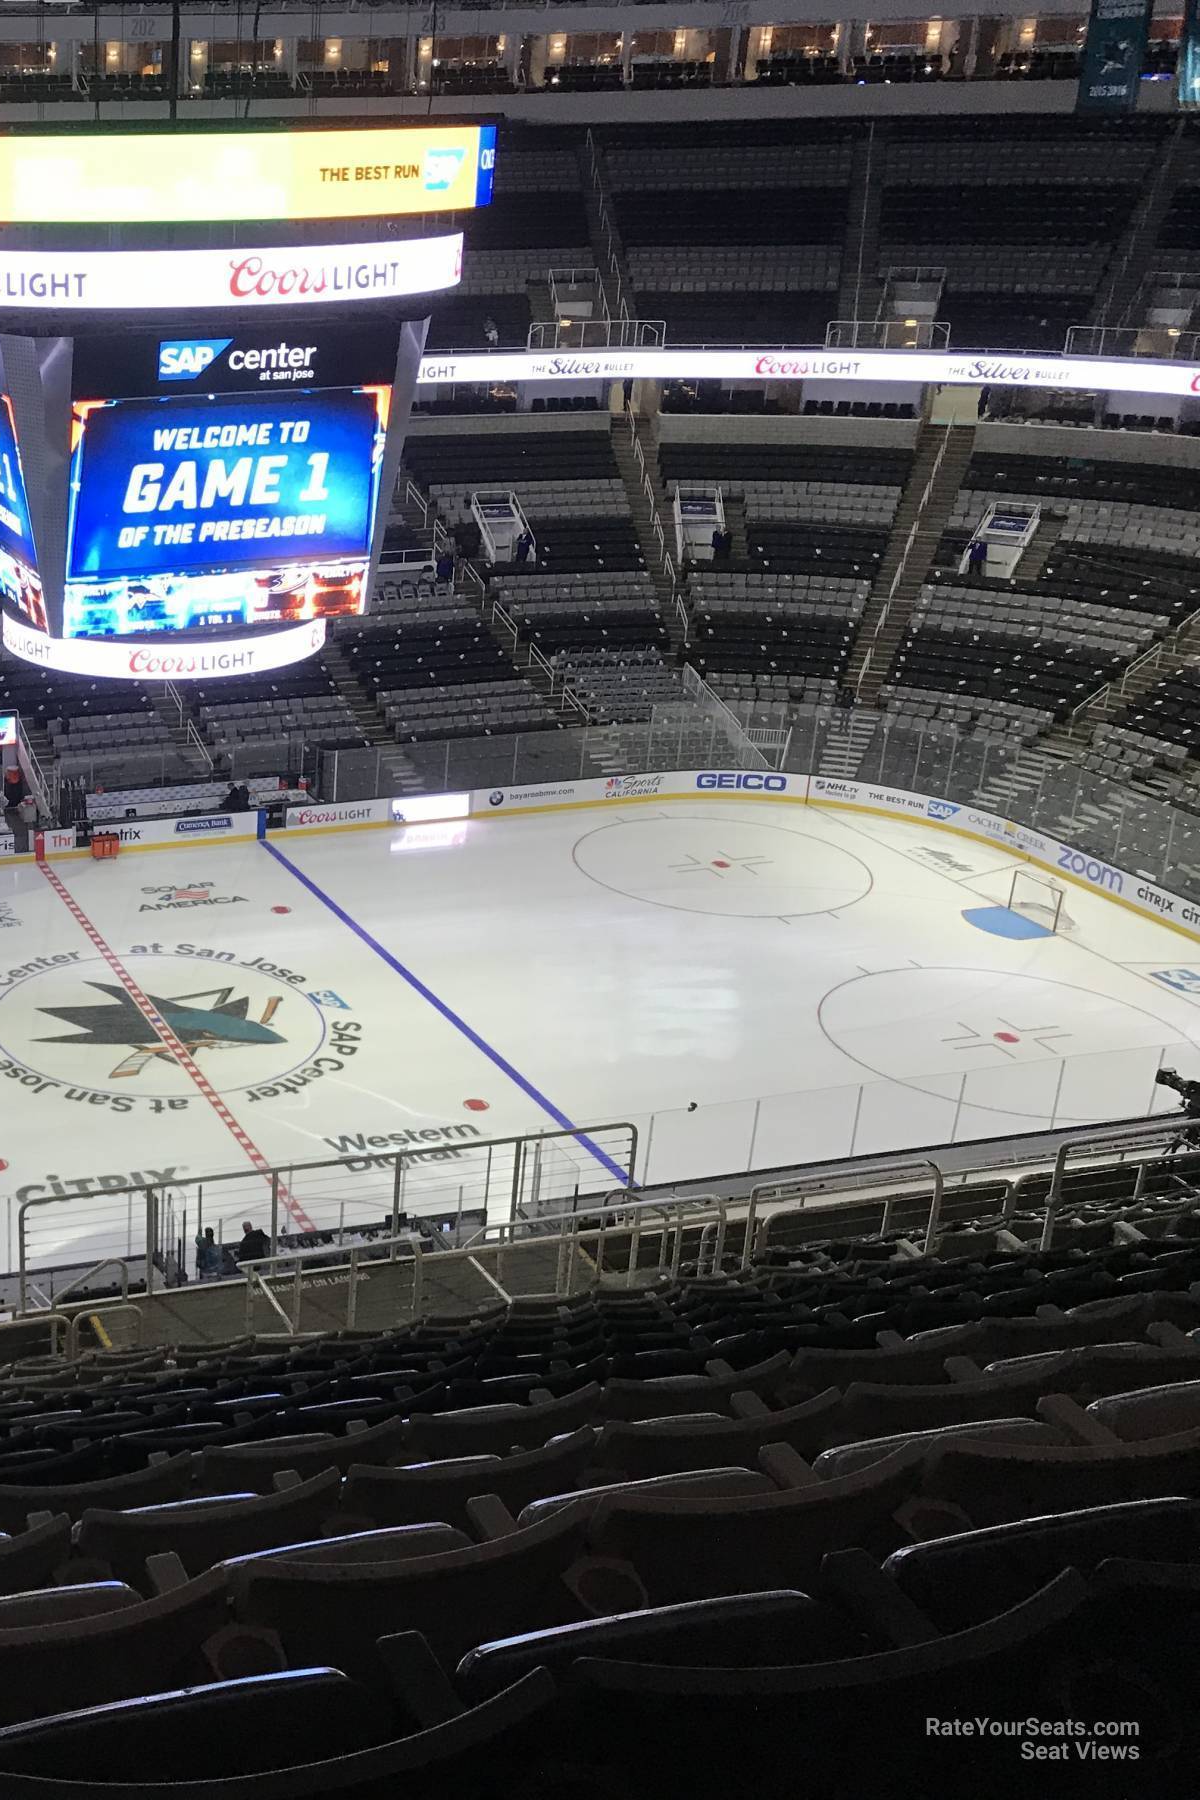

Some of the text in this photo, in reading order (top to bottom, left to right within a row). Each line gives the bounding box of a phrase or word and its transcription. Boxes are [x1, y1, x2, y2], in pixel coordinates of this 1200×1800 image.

[319, 164, 420, 183] THE BEST RUN
[6, 272, 88, 297] LIGHT
[230, 256, 400, 297] Coors LIGHT
[159, 346, 215, 374] SAP
[228, 342, 318, 370] center
[532, 357, 635, 375] THE Silver BULLET
[755, 355, 861, 375] Coors LIGHT
[259, 369, 315, 381] at san jose
[416, 365, 457, 380] IGHT
[948, 359, 1070, 383] THE Silver BULLET
[153, 420, 310, 451] WELCOME TO
[2, 452, 17, 503] 1
[122, 452, 329, 514] GAME 1
[118, 514, 326, 549] OF THE PRESEASON
[18, 640, 51, 660] LIGHT
[129, 650, 255, 673] Coors LIGHT
[605, 786, 658, 799] CALIFORNIA
[623, 775, 665, 790] Sports
[696, 773, 787, 791] GEICO
[868, 792, 925, 810] THE BEST RUN
[929, 802, 953, 818] SAP
[298, 807, 372, 825] Coors LIGHT
[1057, 846, 1124, 893] zoom
[140, 881, 217, 895] SOLAR
[138, 895, 250, 913] AMERICA
[129, 942, 163, 955] at
[173, 943, 236, 962] San
[239, 956, 307, 986] Jose
[329, 1020, 362, 1056] SAP
[245, 1057, 345, 1103] Center
[63, 1088, 137, 1113] San
[148, 1097, 189, 1114] at
[321, 1123, 481, 1153] Western
